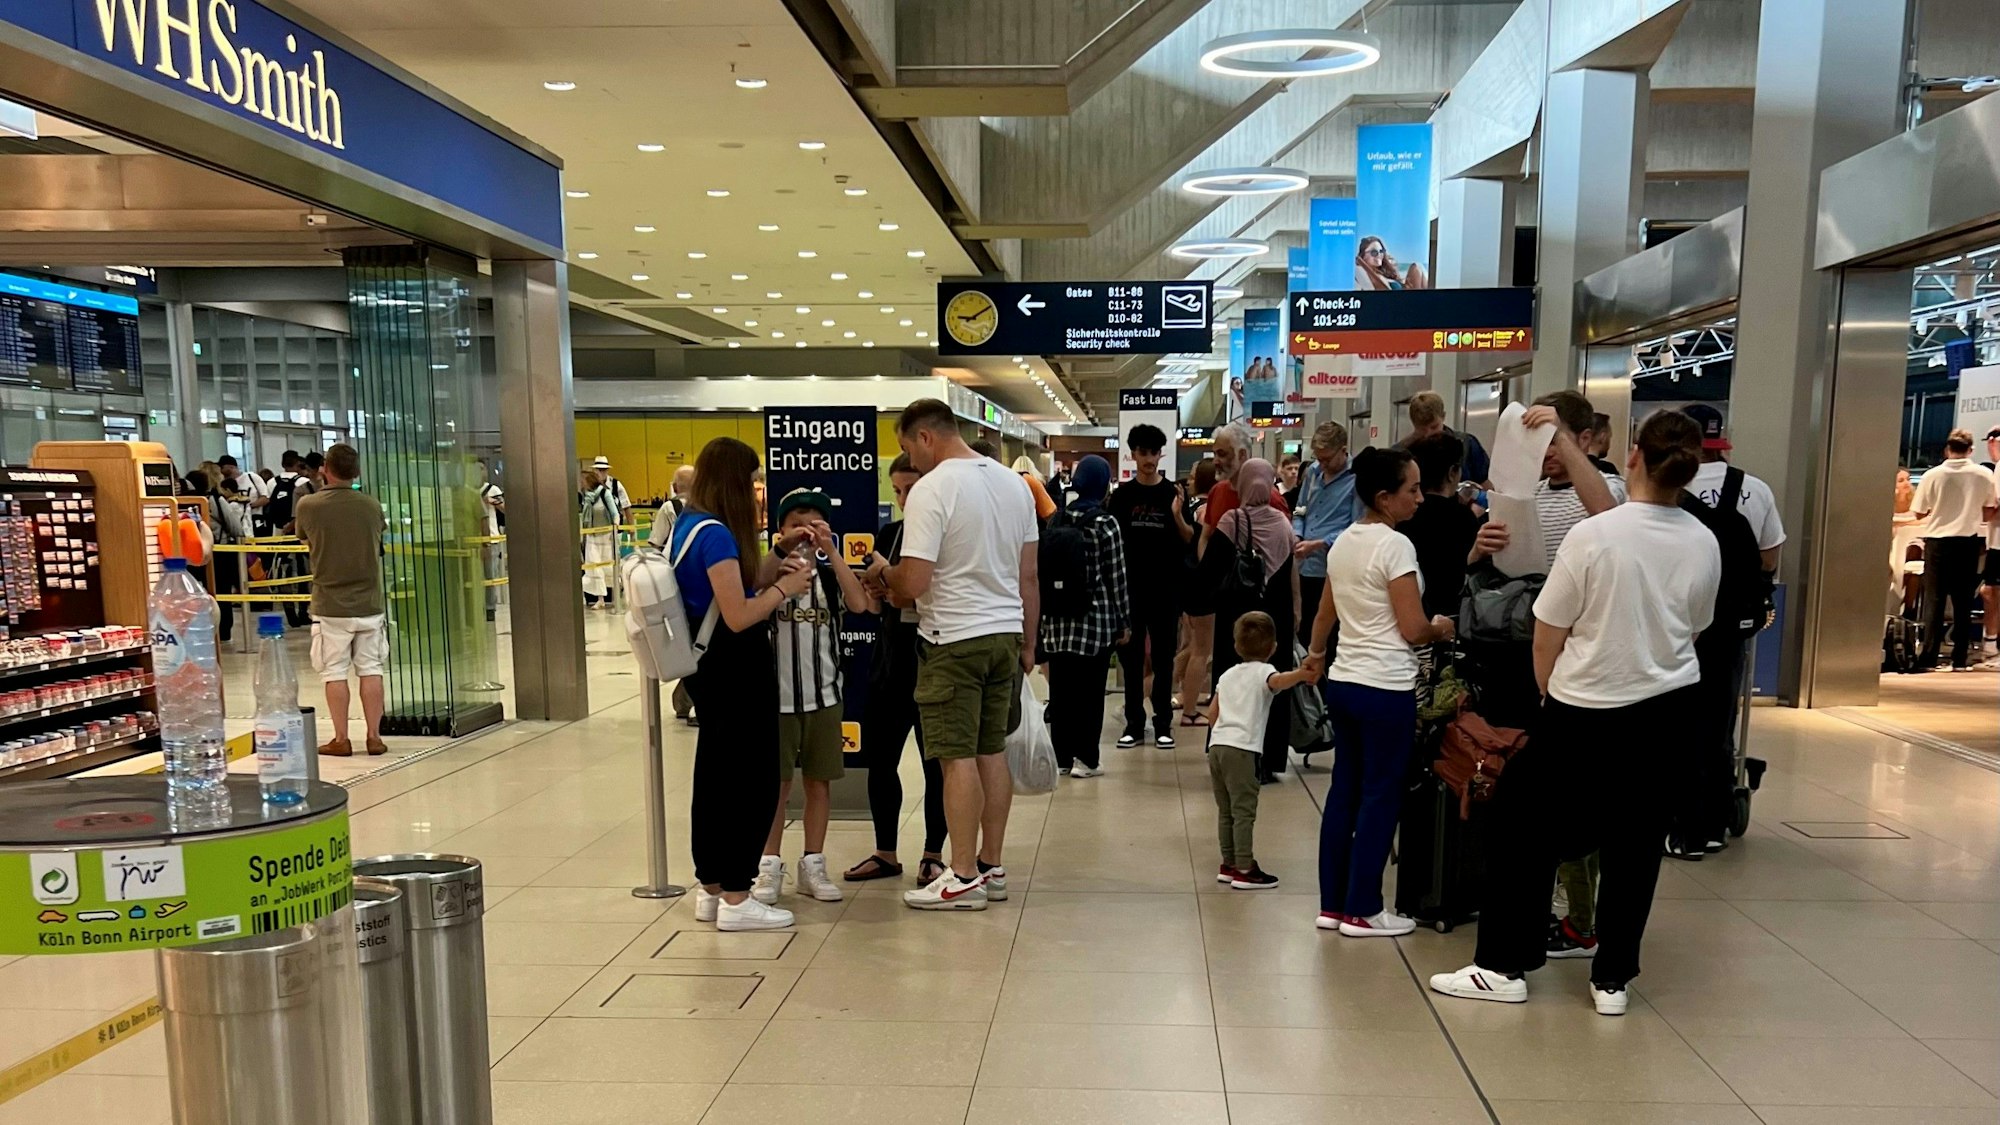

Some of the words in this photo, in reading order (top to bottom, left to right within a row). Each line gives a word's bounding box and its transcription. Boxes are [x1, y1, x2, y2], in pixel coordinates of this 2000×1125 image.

[96, 0, 344, 149] WHSmith
[1367, 152, 1396, 160] Urlaub,
[1397, 151, 1411, 159] wie
[1372, 162, 1386, 171] mir
[1066, 287, 1093, 298] Gates
[1108, 300, 1143, 310] C11-73
[1313, 297, 1361, 310] Check-in
[1108, 313, 1143, 323] D10-82
[1313, 314, 1356, 327] 101-126
[1066, 328, 1161, 338] Sicherheitskontrolle
[1066, 338, 1103, 350] Security
[1105, 338, 1130, 348] check
[1308, 372, 1357, 385] alltours
[1122, 394, 1146, 405] Fast
[1150, 394, 1173, 405] Lane
[768, 414, 865, 444] Eingang
[769, 447, 873, 471] Entrance
[777, 601, 830, 627] Jeep
[151, 633, 178, 646] SPA
[249, 843, 324, 888] Spende
[250, 894, 267, 907] an
[38, 931, 75, 947] Köln
[82, 930, 122, 945] Bonn
[129, 923, 192, 943] Airport
[357, 934, 387, 949] stics
